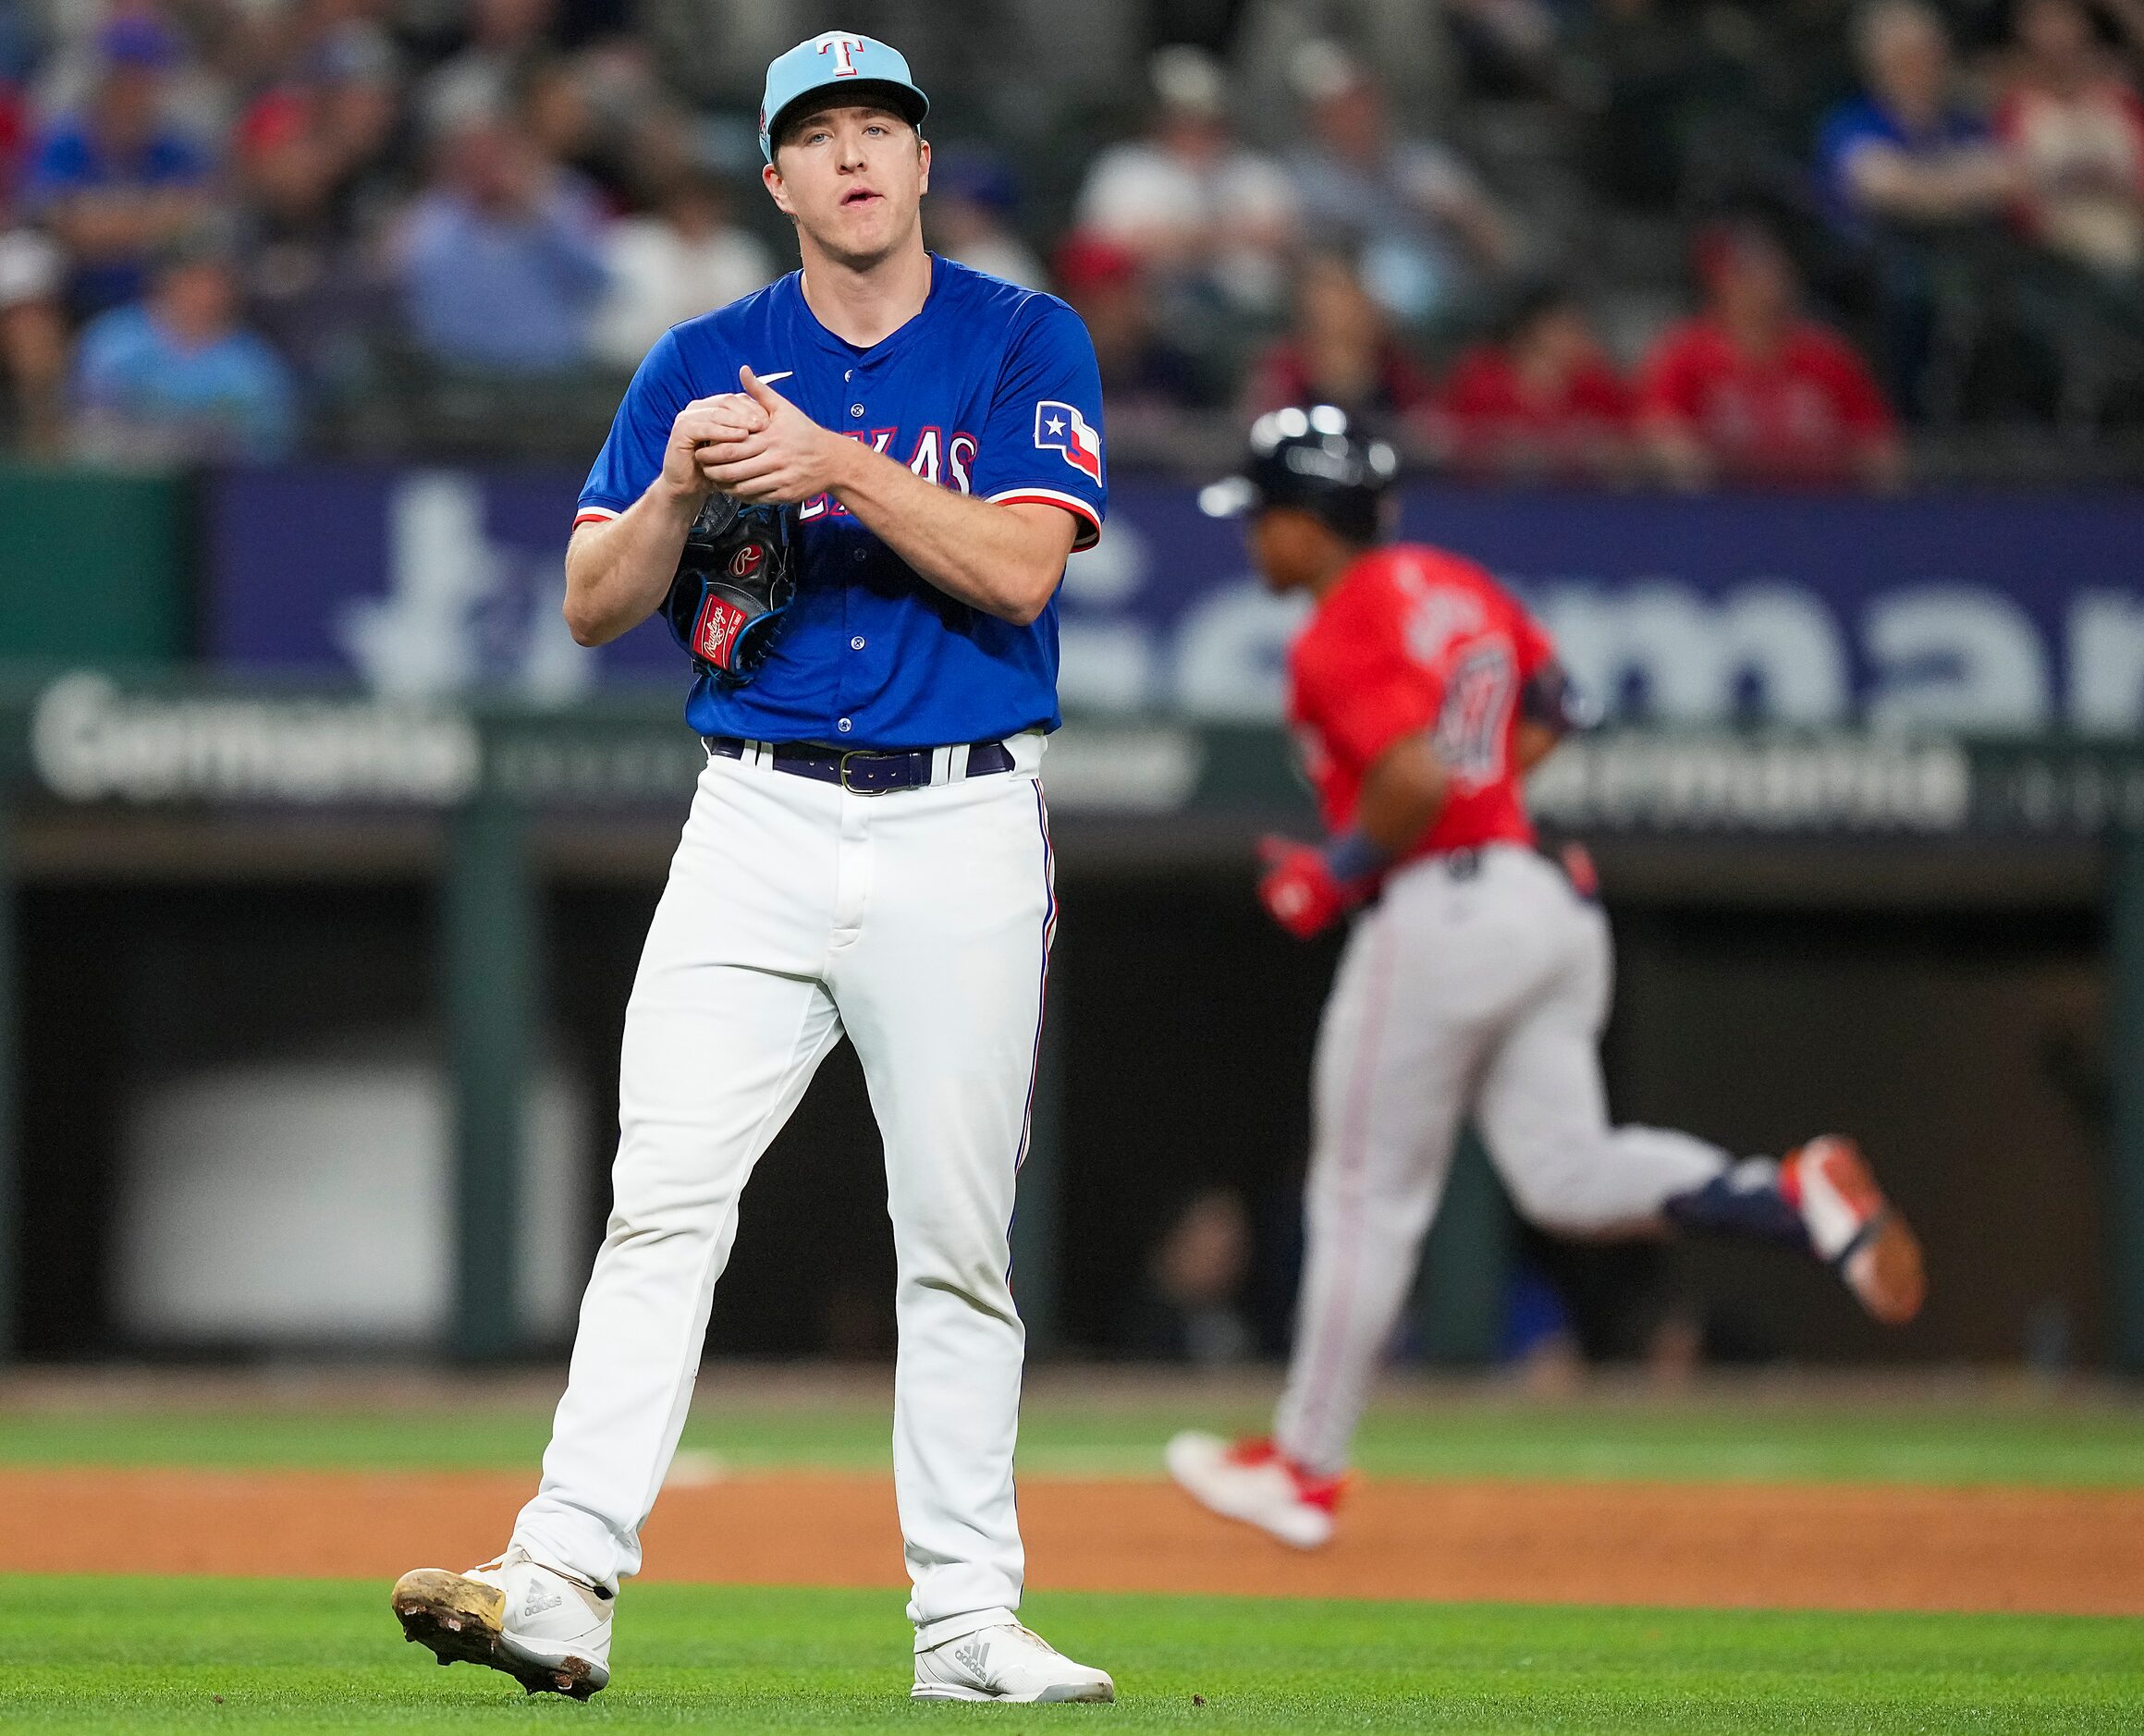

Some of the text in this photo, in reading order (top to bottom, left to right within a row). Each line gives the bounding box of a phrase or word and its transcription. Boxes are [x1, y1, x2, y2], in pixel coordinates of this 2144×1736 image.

[815, 36, 864, 78] T
[704, 605, 727, 658] Rawlings
[524, 1595, 563, 1617] adidas
[954, 1649, 987, 1682] adidas
